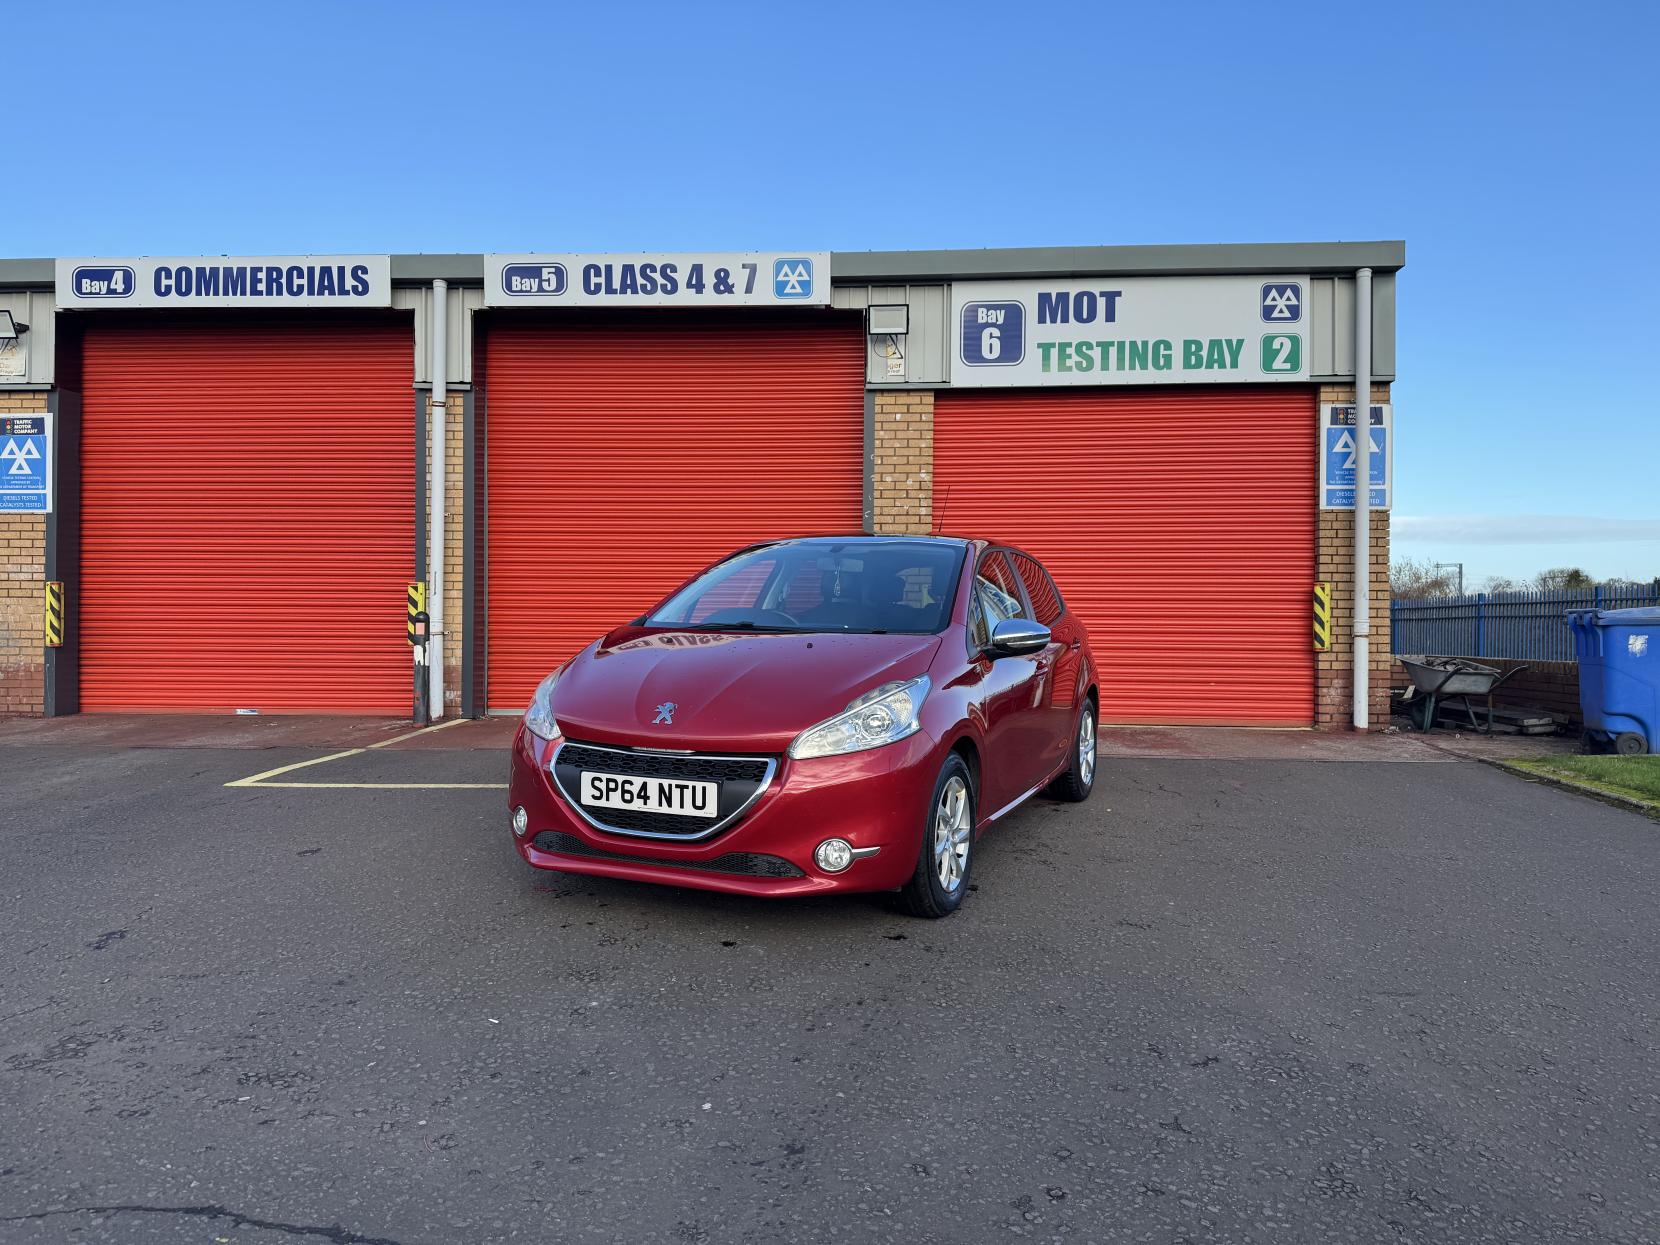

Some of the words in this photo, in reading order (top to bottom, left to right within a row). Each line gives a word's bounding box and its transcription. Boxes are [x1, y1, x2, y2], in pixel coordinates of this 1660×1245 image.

[81, 278, 108, 294] Bay
[110, 270, 125, 293] 4
[154, 265, 370, 297] COMMERCIALS
[511, 276, 538, 292] Bay
[541, 268, 557, 291] 5
[582, 263, 679, 296] CLASS
[685, 264, 706, 294] 4
[712, 268, 735, 294] &
[741, 263, 758, 293] 7
[977, 308, 1006, 324] Bay
[1037, 291, 1122, 324] MOT
[981, 328, 1001, 360] 6
[1037, 339, 1173, 373] TESTING
[1182, 339, 1245, 370] BAY
[1272, 337, 1292, 370] 2
[590, 776, 651, 806] SP64
[658, 782, 707, 811] NTU
